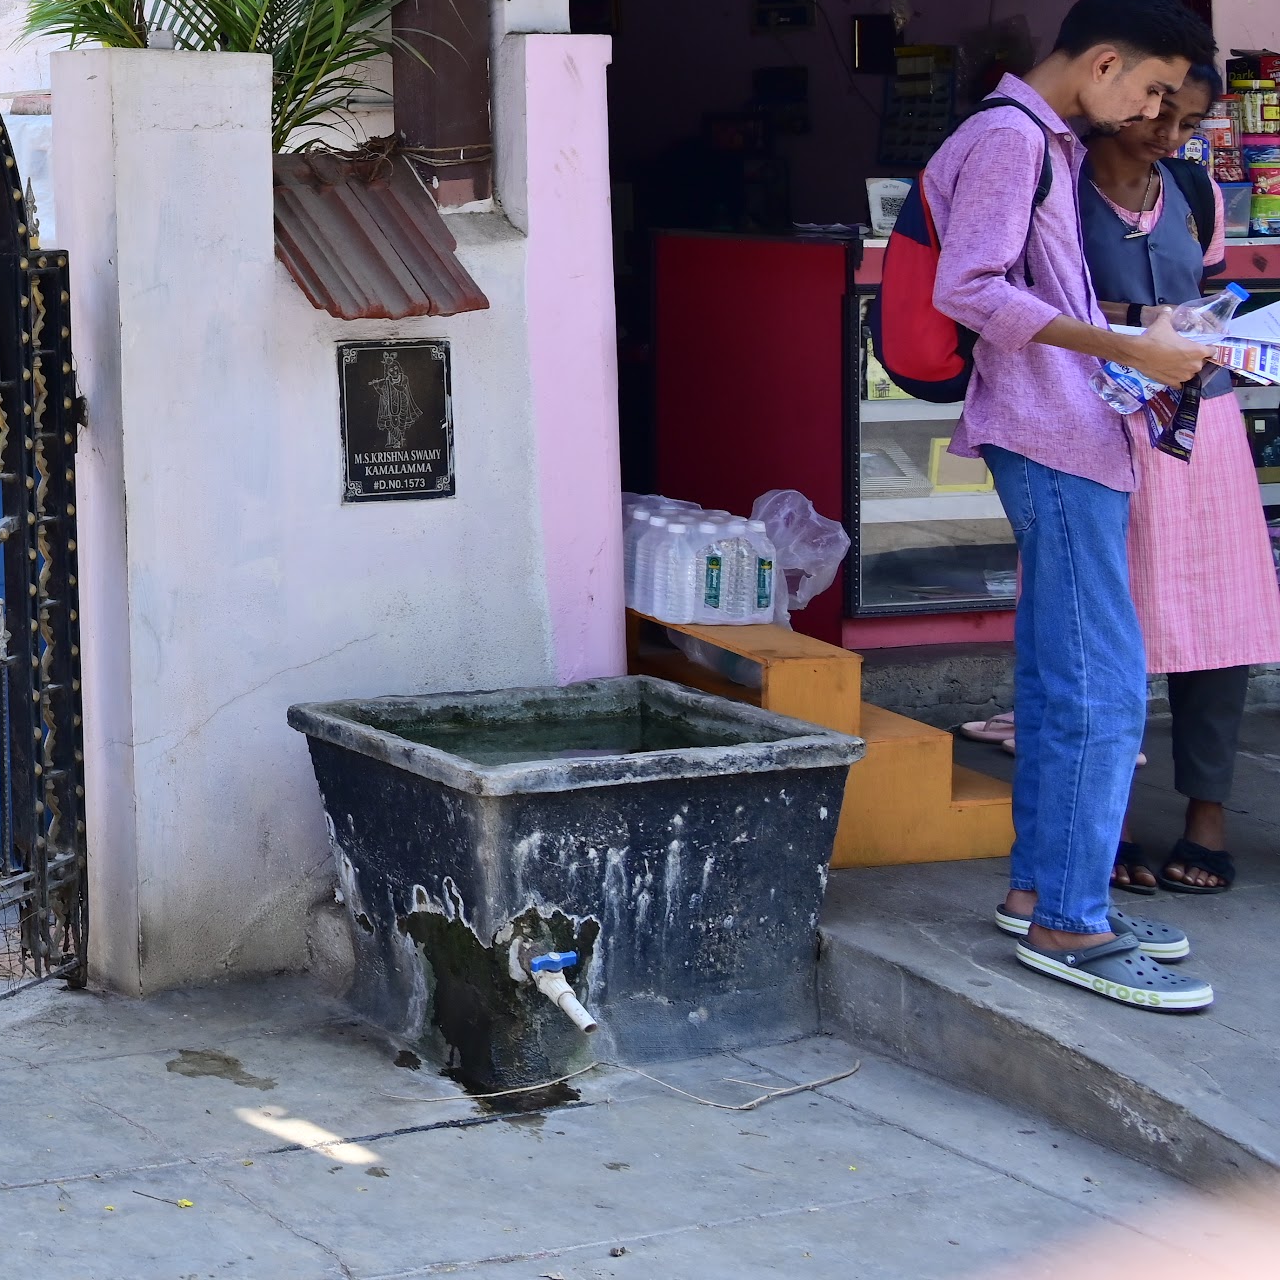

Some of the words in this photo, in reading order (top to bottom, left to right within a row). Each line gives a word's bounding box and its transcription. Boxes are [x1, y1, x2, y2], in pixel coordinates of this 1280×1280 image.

[1228, 69, 1255, 82] Dark
[354, 451, 409, 465] M.S.KRISHNA
[411, 449, 441, 461] SWAMY
[365, 462, 432, 476] KAMALAMMA
